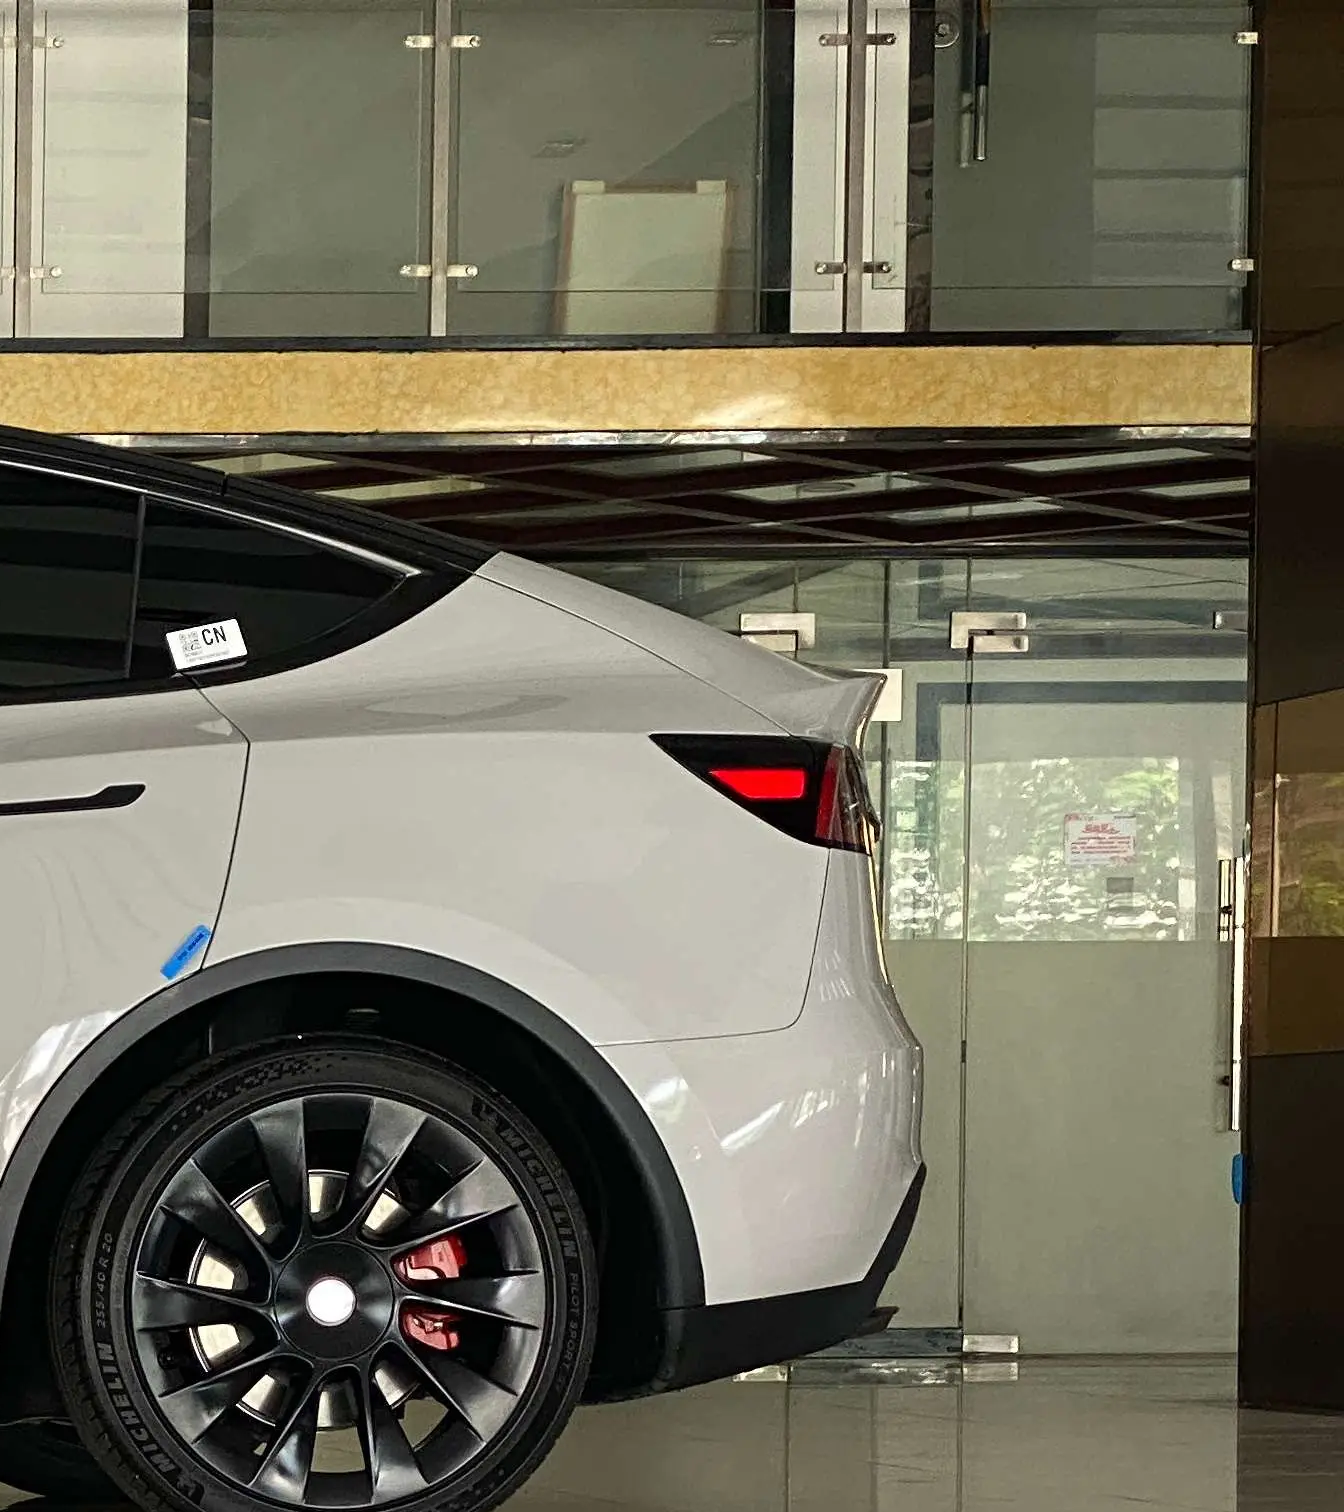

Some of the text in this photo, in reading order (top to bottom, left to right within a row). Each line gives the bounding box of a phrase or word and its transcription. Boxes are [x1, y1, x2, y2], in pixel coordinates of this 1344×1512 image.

[201, 625, 227, 646] CN
[500, 1127, 578, 1259] MICHELIN
[95, 1232, 176, 1474] MICHELIN 255/40 R 20
